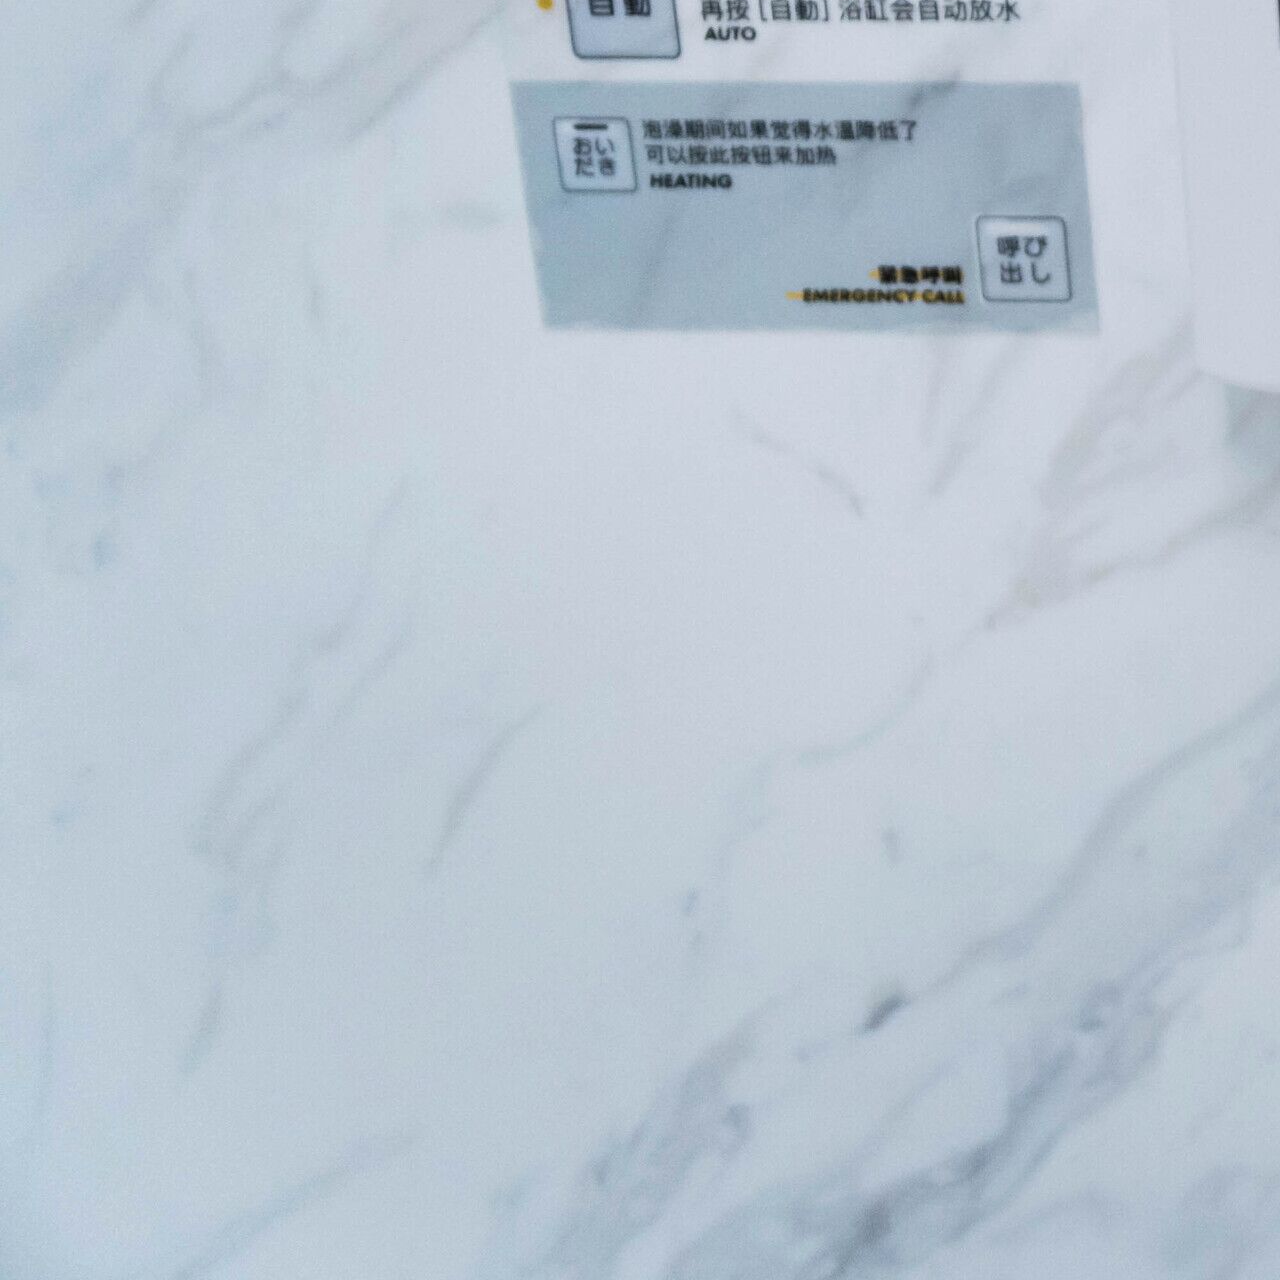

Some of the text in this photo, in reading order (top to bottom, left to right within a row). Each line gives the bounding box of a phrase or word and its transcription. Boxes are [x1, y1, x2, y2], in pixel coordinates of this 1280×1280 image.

[705, 27, 757, 42] AUTO
[650, 173, 732, 189] HEATING
[803, 288, 965, 304] EMERGENCY CALL
